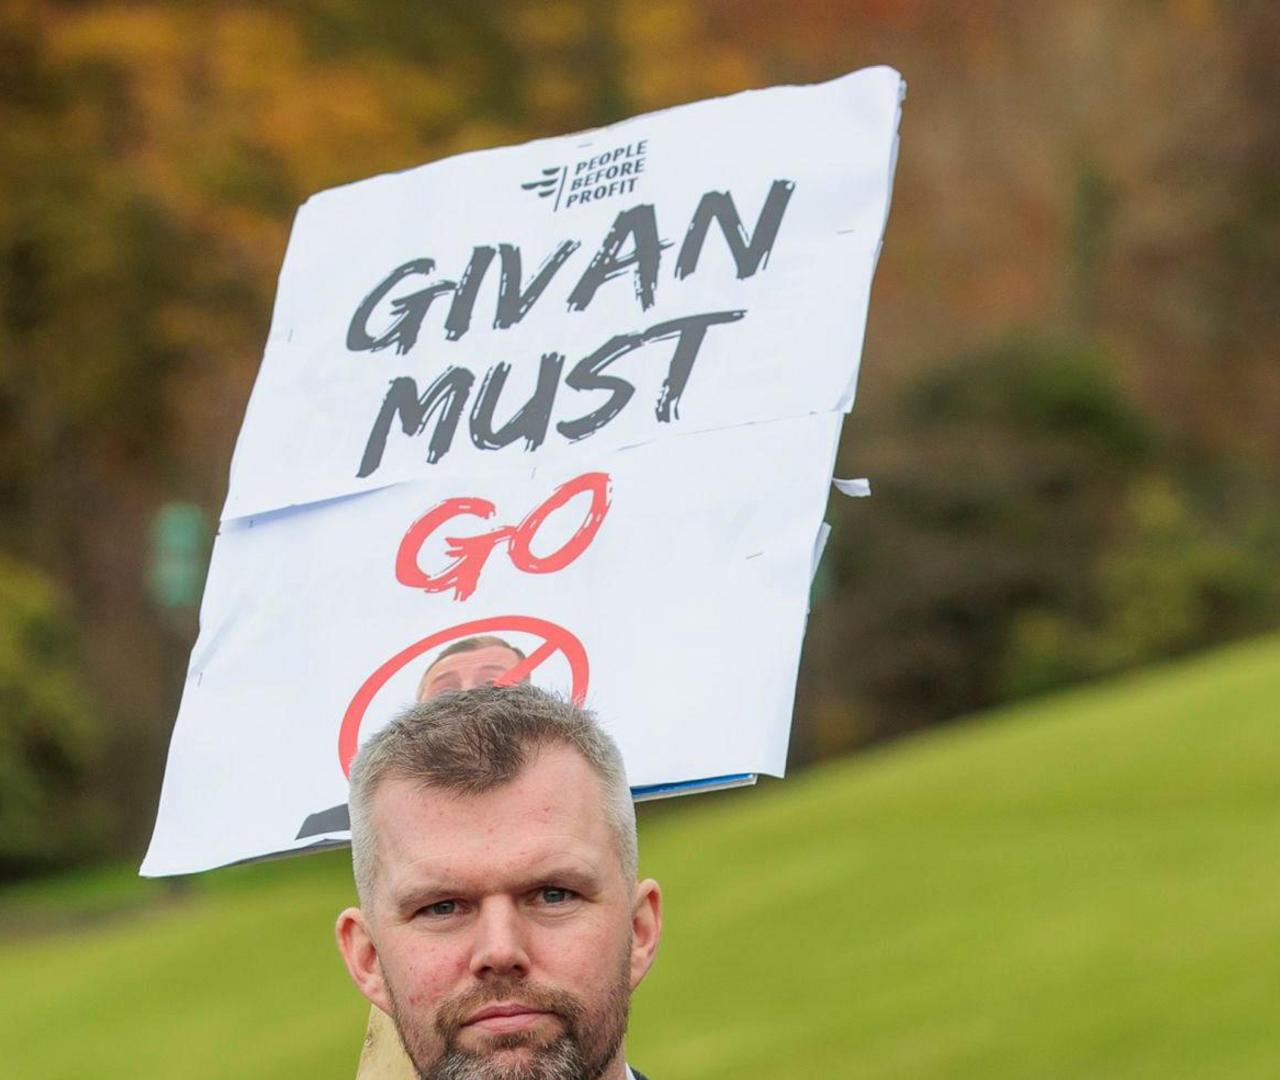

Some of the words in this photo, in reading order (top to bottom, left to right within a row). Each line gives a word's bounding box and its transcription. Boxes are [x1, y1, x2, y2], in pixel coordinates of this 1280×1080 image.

[566, 177, 639, 208] PROFIT
[570, 157, 646, 192] BEFORE
[575, 139, 648, 175] PEOPLE
[345, 178, 796, 355] GIVAN
[355, 309, 749, 479] MUST
[395, 471, 612, 602] GO
